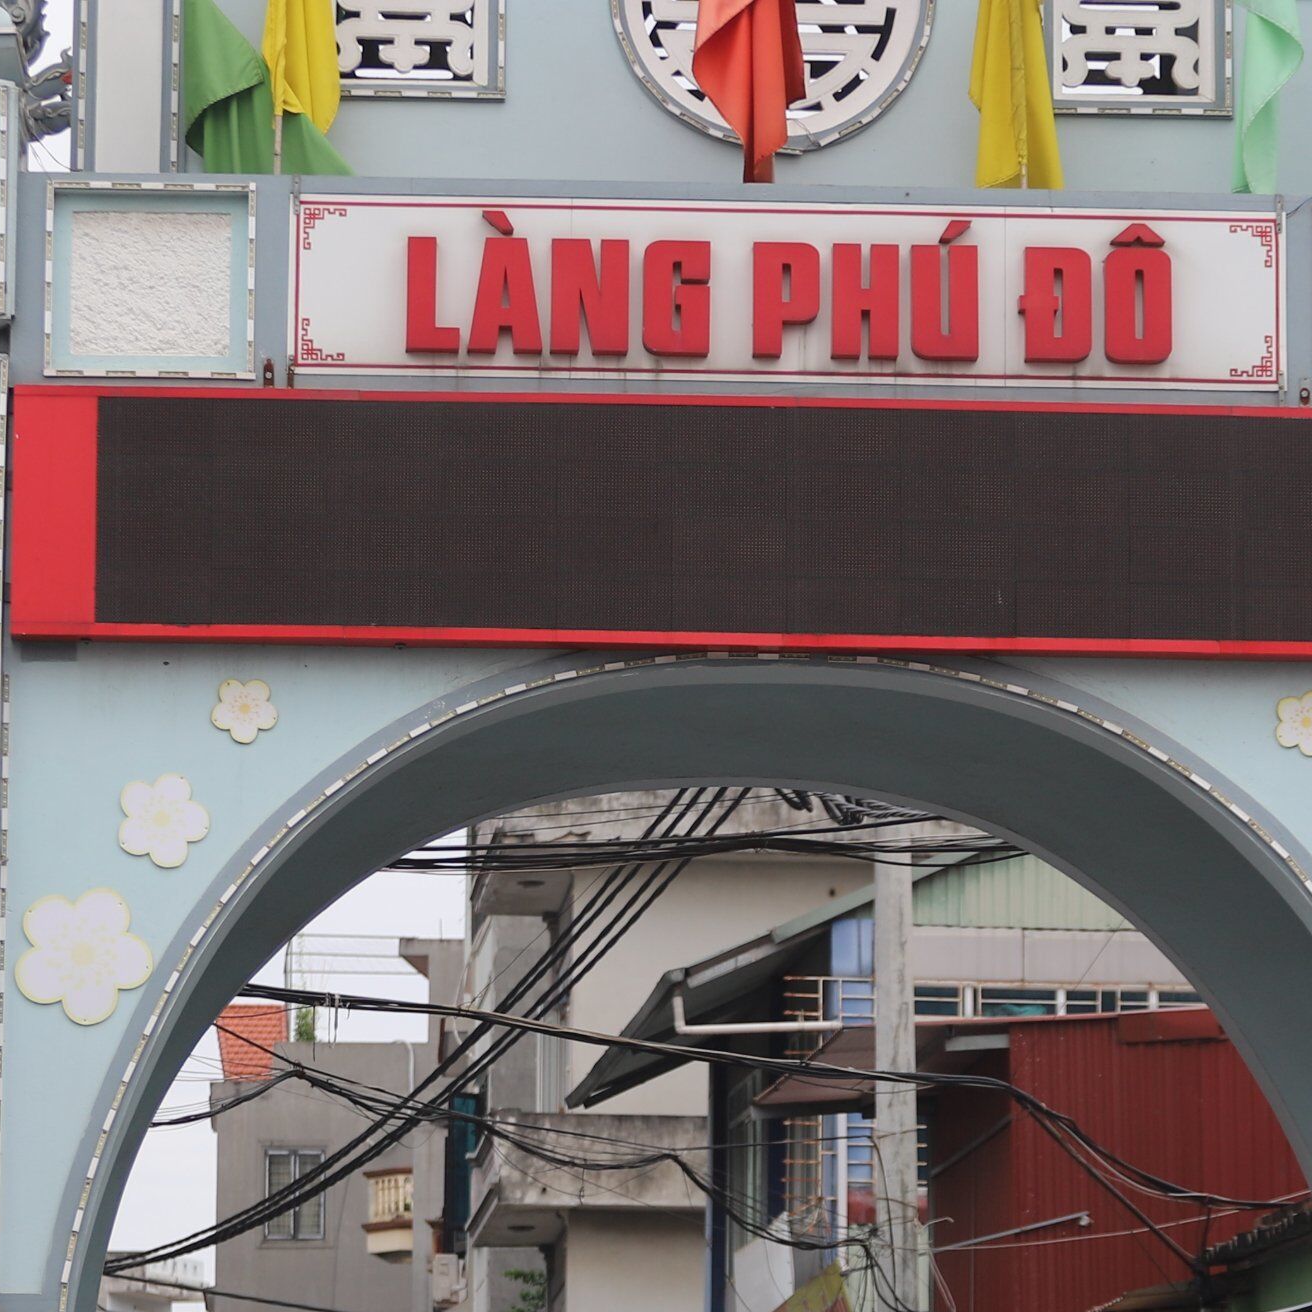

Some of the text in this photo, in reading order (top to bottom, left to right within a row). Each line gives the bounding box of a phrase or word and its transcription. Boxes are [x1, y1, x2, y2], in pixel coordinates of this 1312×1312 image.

[406, 210, 1174, 365] LÀNG PHÚ ĐÔ
